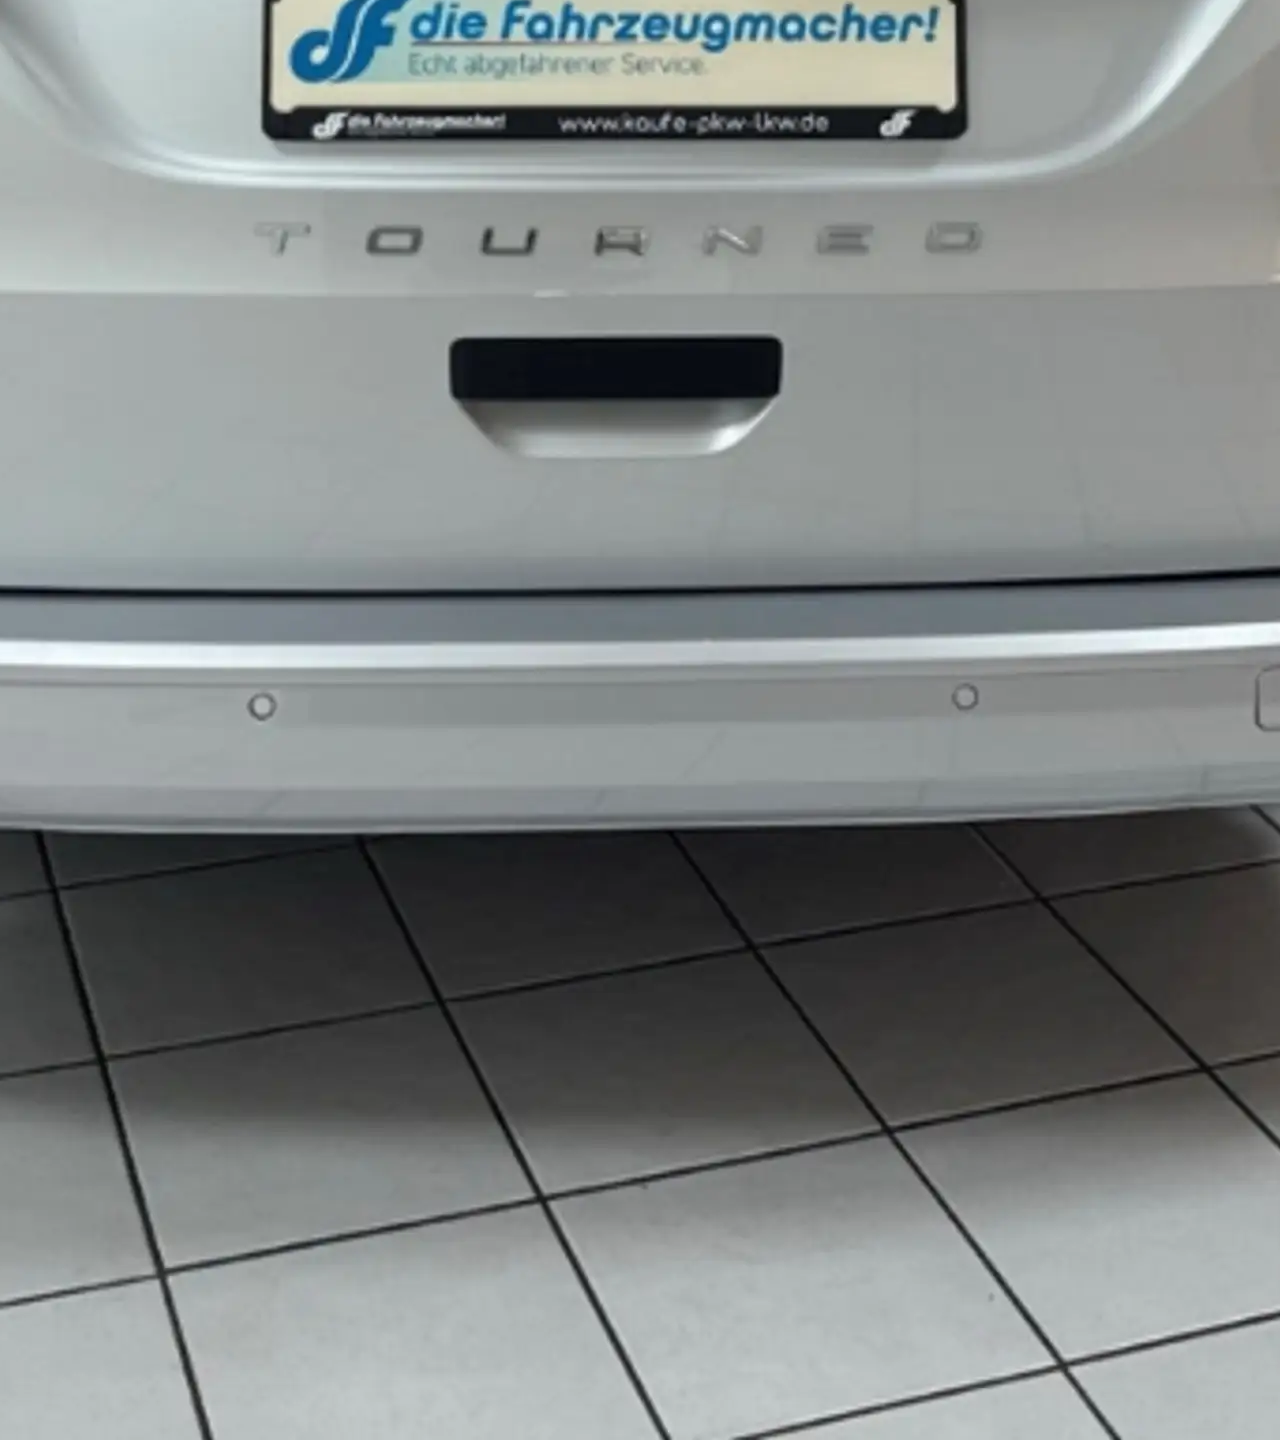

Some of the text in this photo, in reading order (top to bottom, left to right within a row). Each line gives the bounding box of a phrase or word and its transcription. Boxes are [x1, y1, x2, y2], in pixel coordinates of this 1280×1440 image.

[410, 1, 487, 40] die
[408, 53, 457, 75] Echt
[463, 53, 612, 78] abgefahrener
[254, 222, 984, 257] TOURNEO
